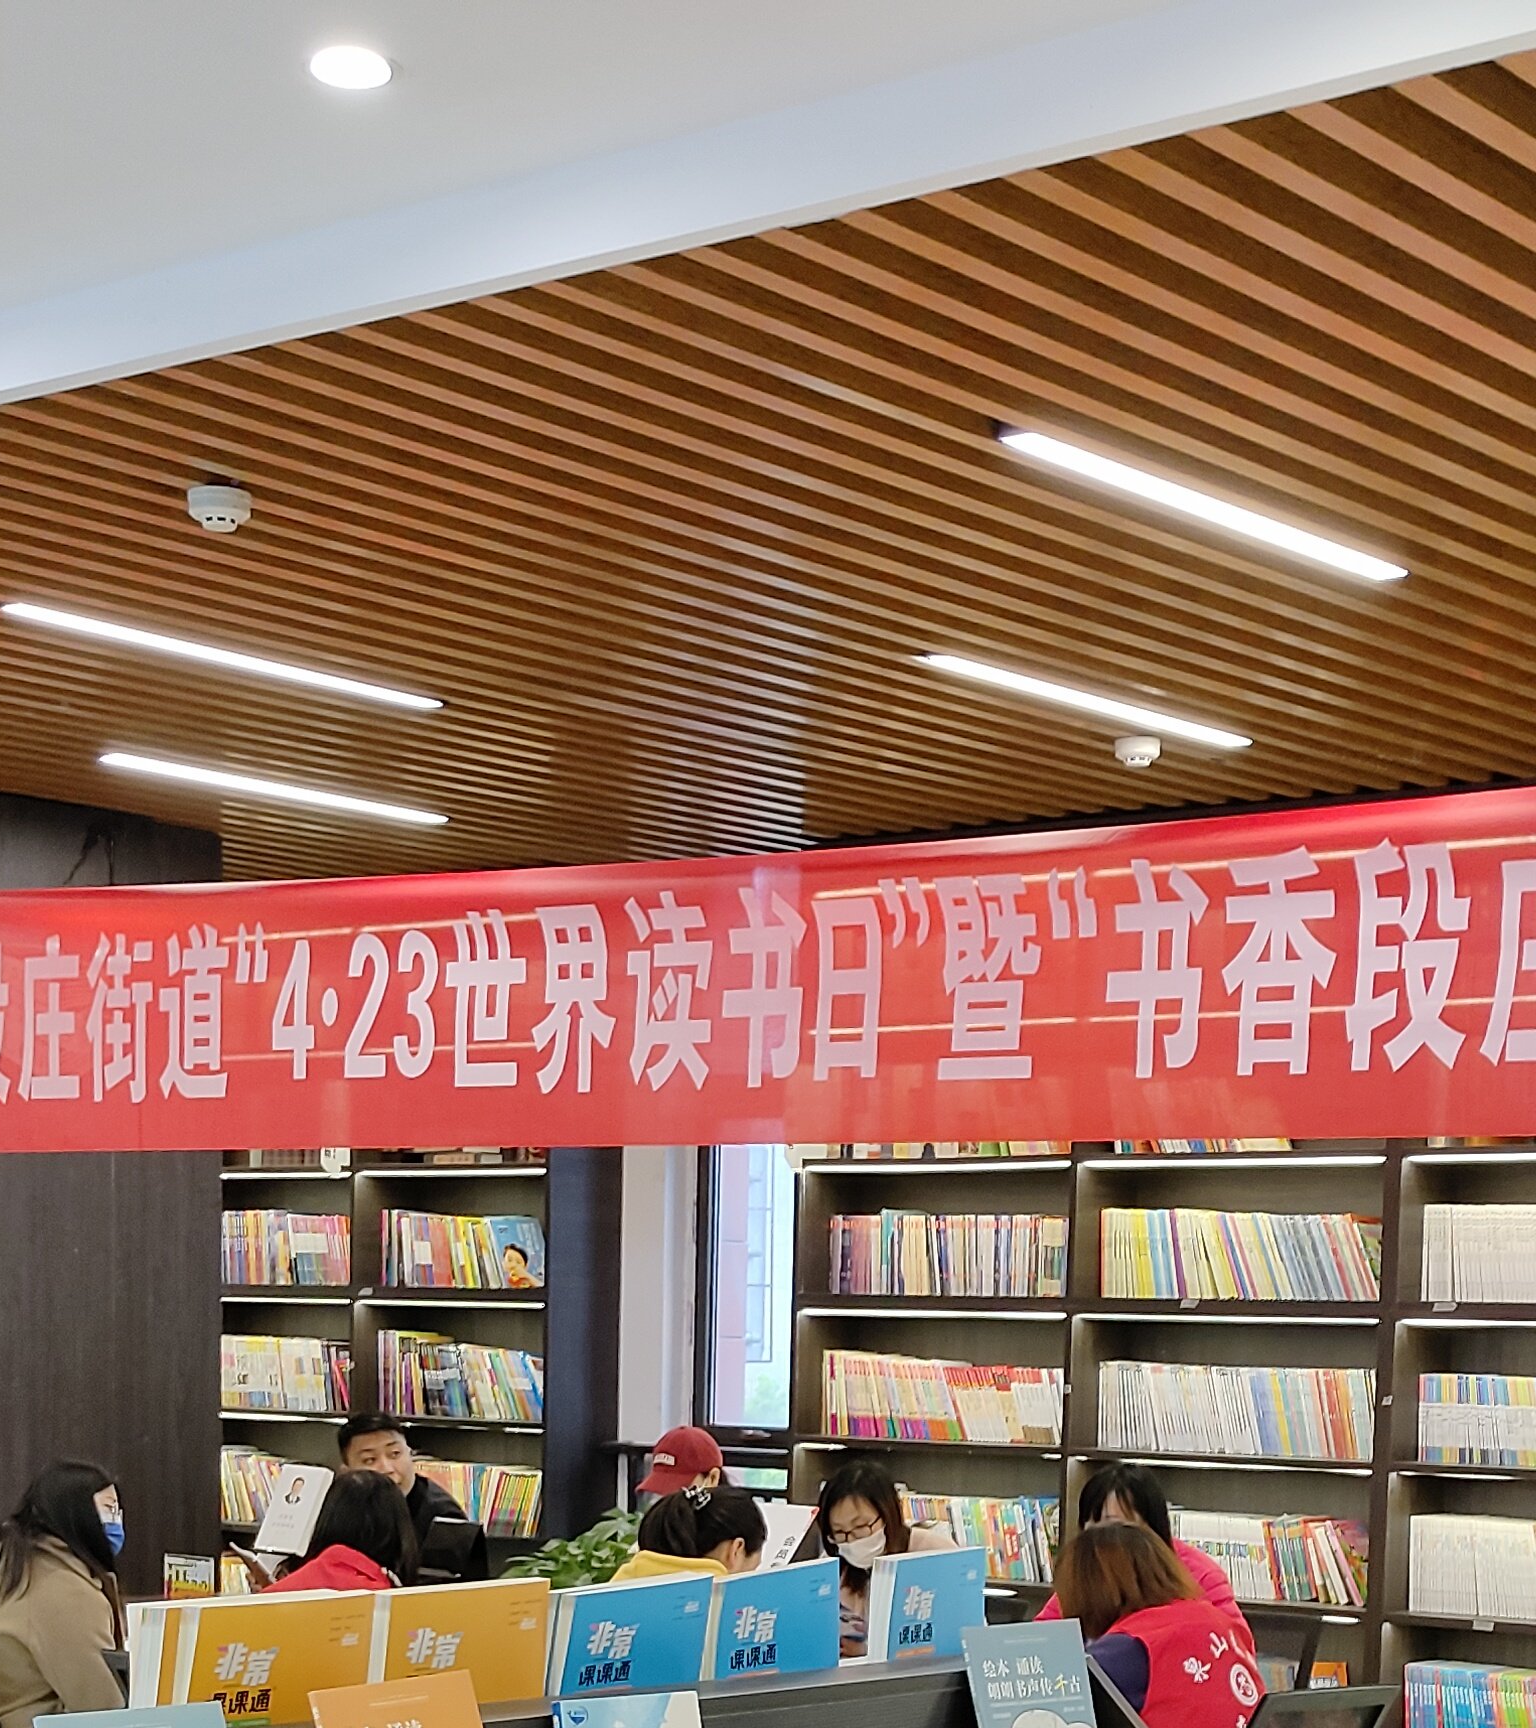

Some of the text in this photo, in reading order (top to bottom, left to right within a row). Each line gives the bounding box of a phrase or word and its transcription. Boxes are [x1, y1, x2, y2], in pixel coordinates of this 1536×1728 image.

[903, 1585, 936, 1621] 非常
[586, 1620, 639, 1660] 非常
[732, 1606, 779, 1643] 非常
[898, 1622, 935, 1646] 课课通
[214, 1641, 280, 1687] 非常
[405, 1627, 465, 1670] 非常
[730, 1643, 777, 1670] 课课通
[578, 1660, 632, 1686] 课课通
[982, 1655, 1045, 1678] 绘本 诵读
[987, 1673, 1081, 1700] 朗朗书声传千古
